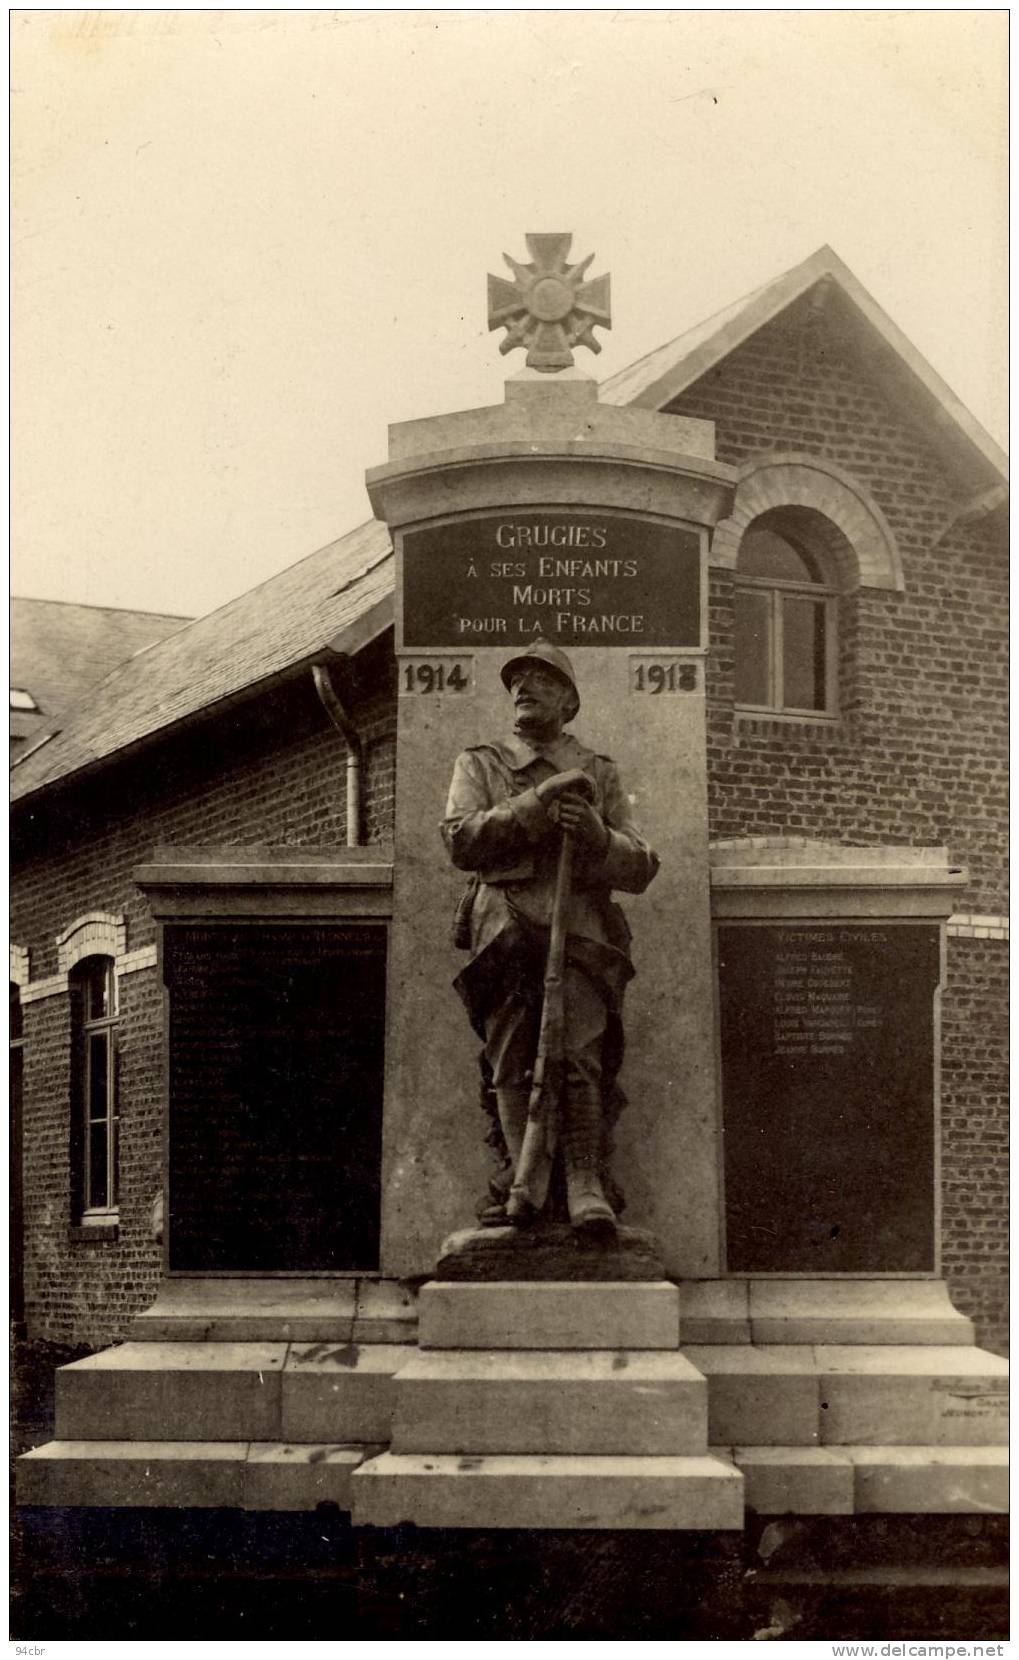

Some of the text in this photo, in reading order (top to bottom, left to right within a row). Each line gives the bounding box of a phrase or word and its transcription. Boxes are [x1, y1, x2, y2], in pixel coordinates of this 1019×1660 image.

[496, 524, 607, 548] GRUGIES
[490, 563, 526, 577] SES
[539, 557, 637, 577] ENFANTS
[513, 585, 591, 606] MORTS
[460, 612, 645, 633] POUR LA FRANCE
[404, 664, 468, 694] 1914
[634, 664, 697, 694] 1918
[778, 931, 887, 942] VICTIMES CIVILES
